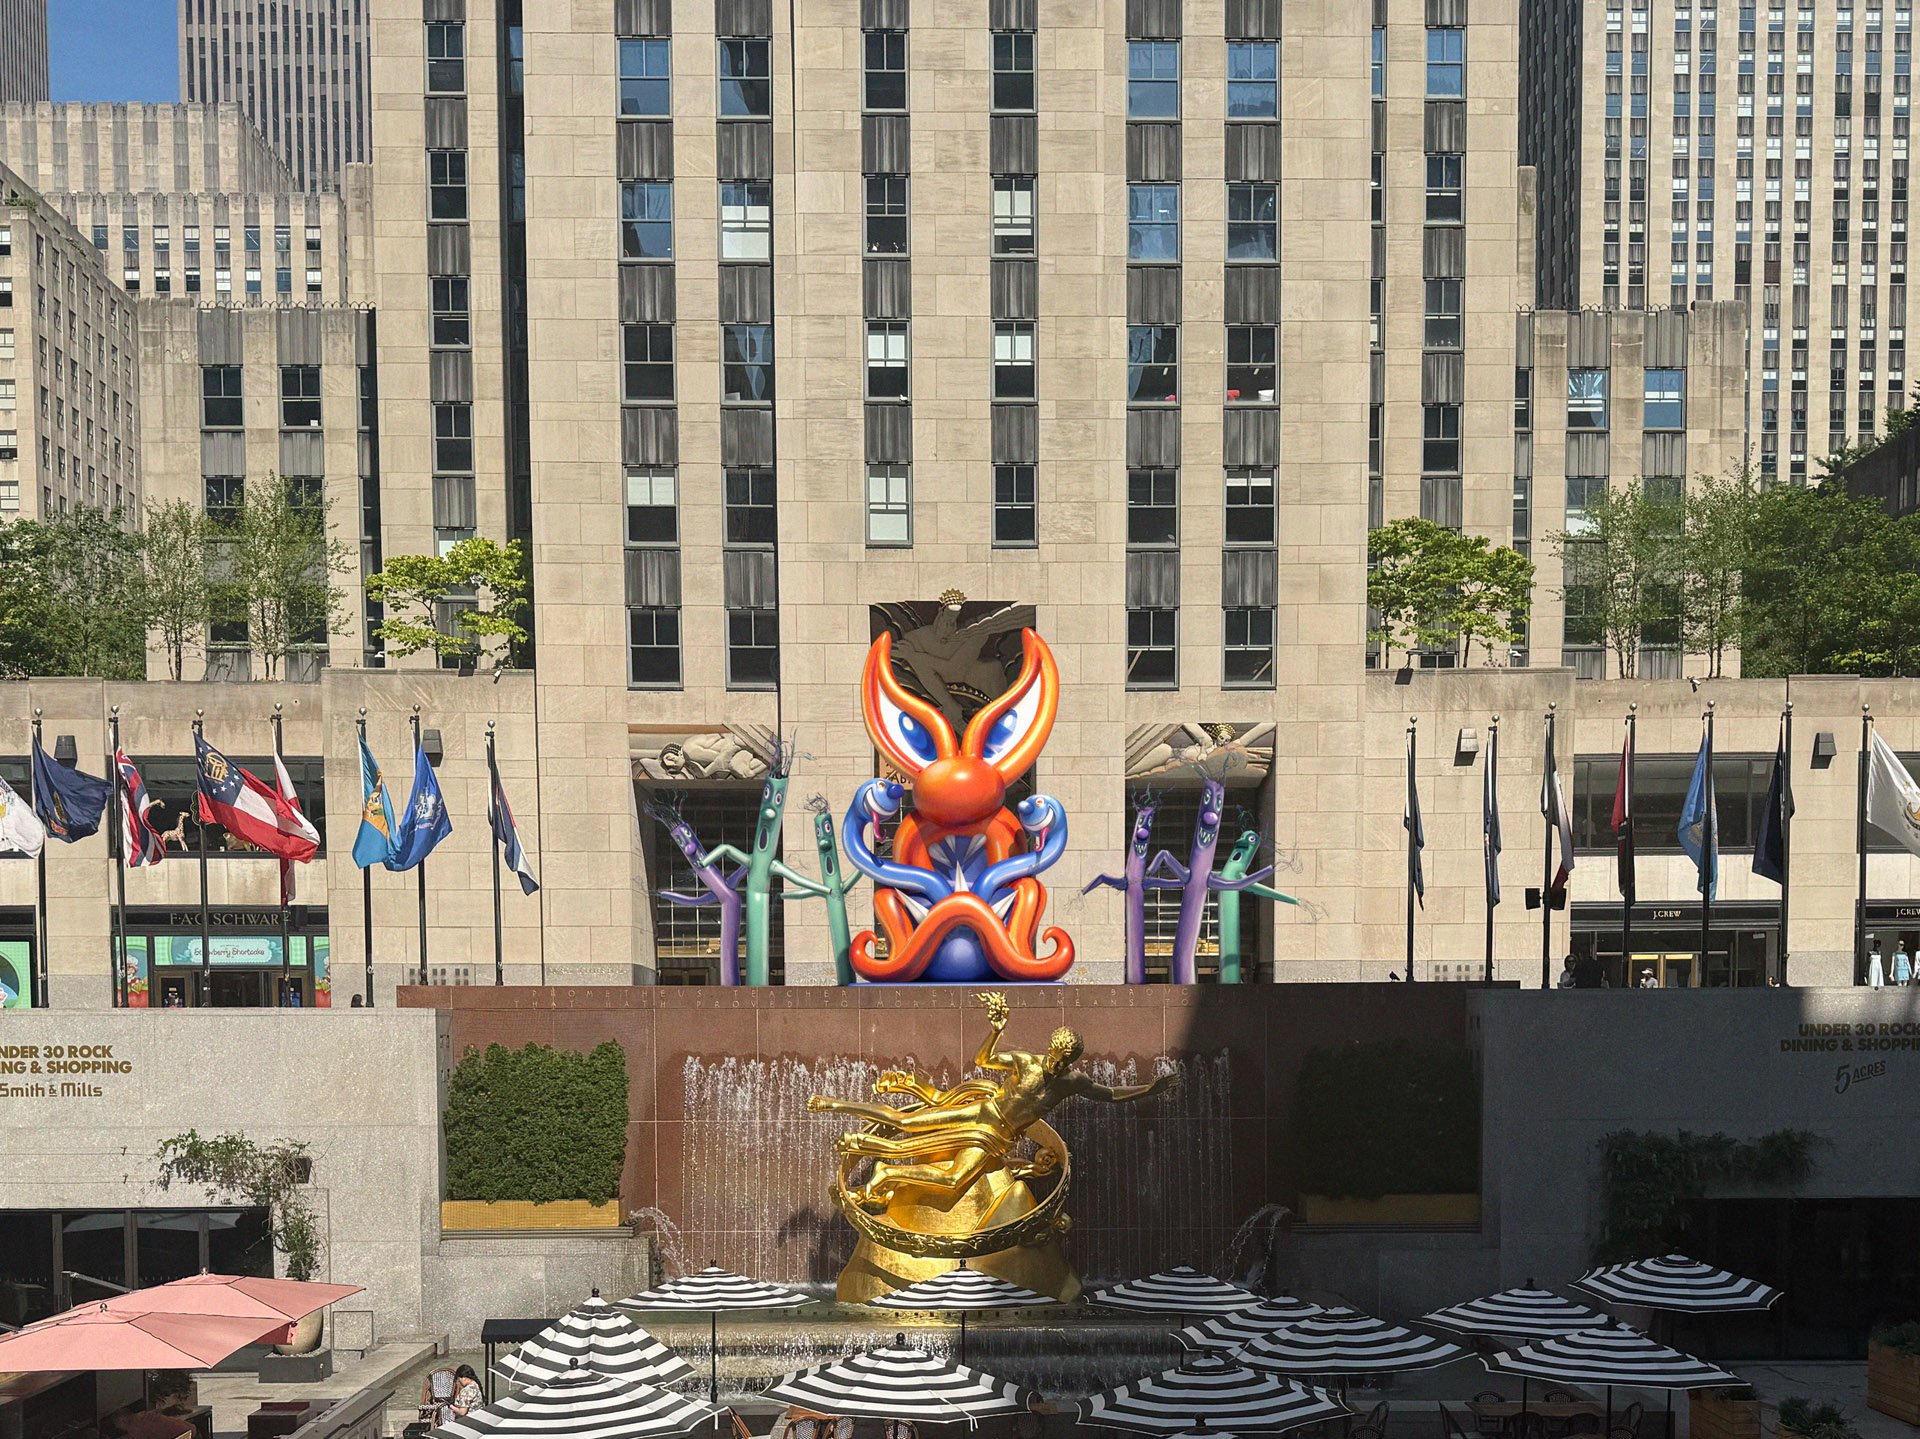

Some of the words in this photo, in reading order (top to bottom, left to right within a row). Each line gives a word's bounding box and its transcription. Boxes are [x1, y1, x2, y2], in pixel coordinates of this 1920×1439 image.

[213, 913, 281, 925] SCHWAR
[1798, 1023, 1852, 1037] UNDER
[1855, 1023, 1876, 1036] 30
[0, 1045, 40, 1059] NDER
[43, 1045, 65, 1059] 30
[67, 1045, 114, 1059] ROCK
[1780, 1039, 1839, 1052] DINING
[1841, 1039, 1854, 1052] &
[1857, 1038, 1920, 1052] SHOPPI
[30, 1060, 43, 1074] &
[46, 1060, 133, 1074] SHOPPING
[1834, 1064, 1851, 1095] 5
[1852, 1060, 1888, 1080] ACRES
[0, 1082, 46, 1097] Smith
[48, 1084, 58, 1097] &
[60, 1082, 103, 1097] Mills
